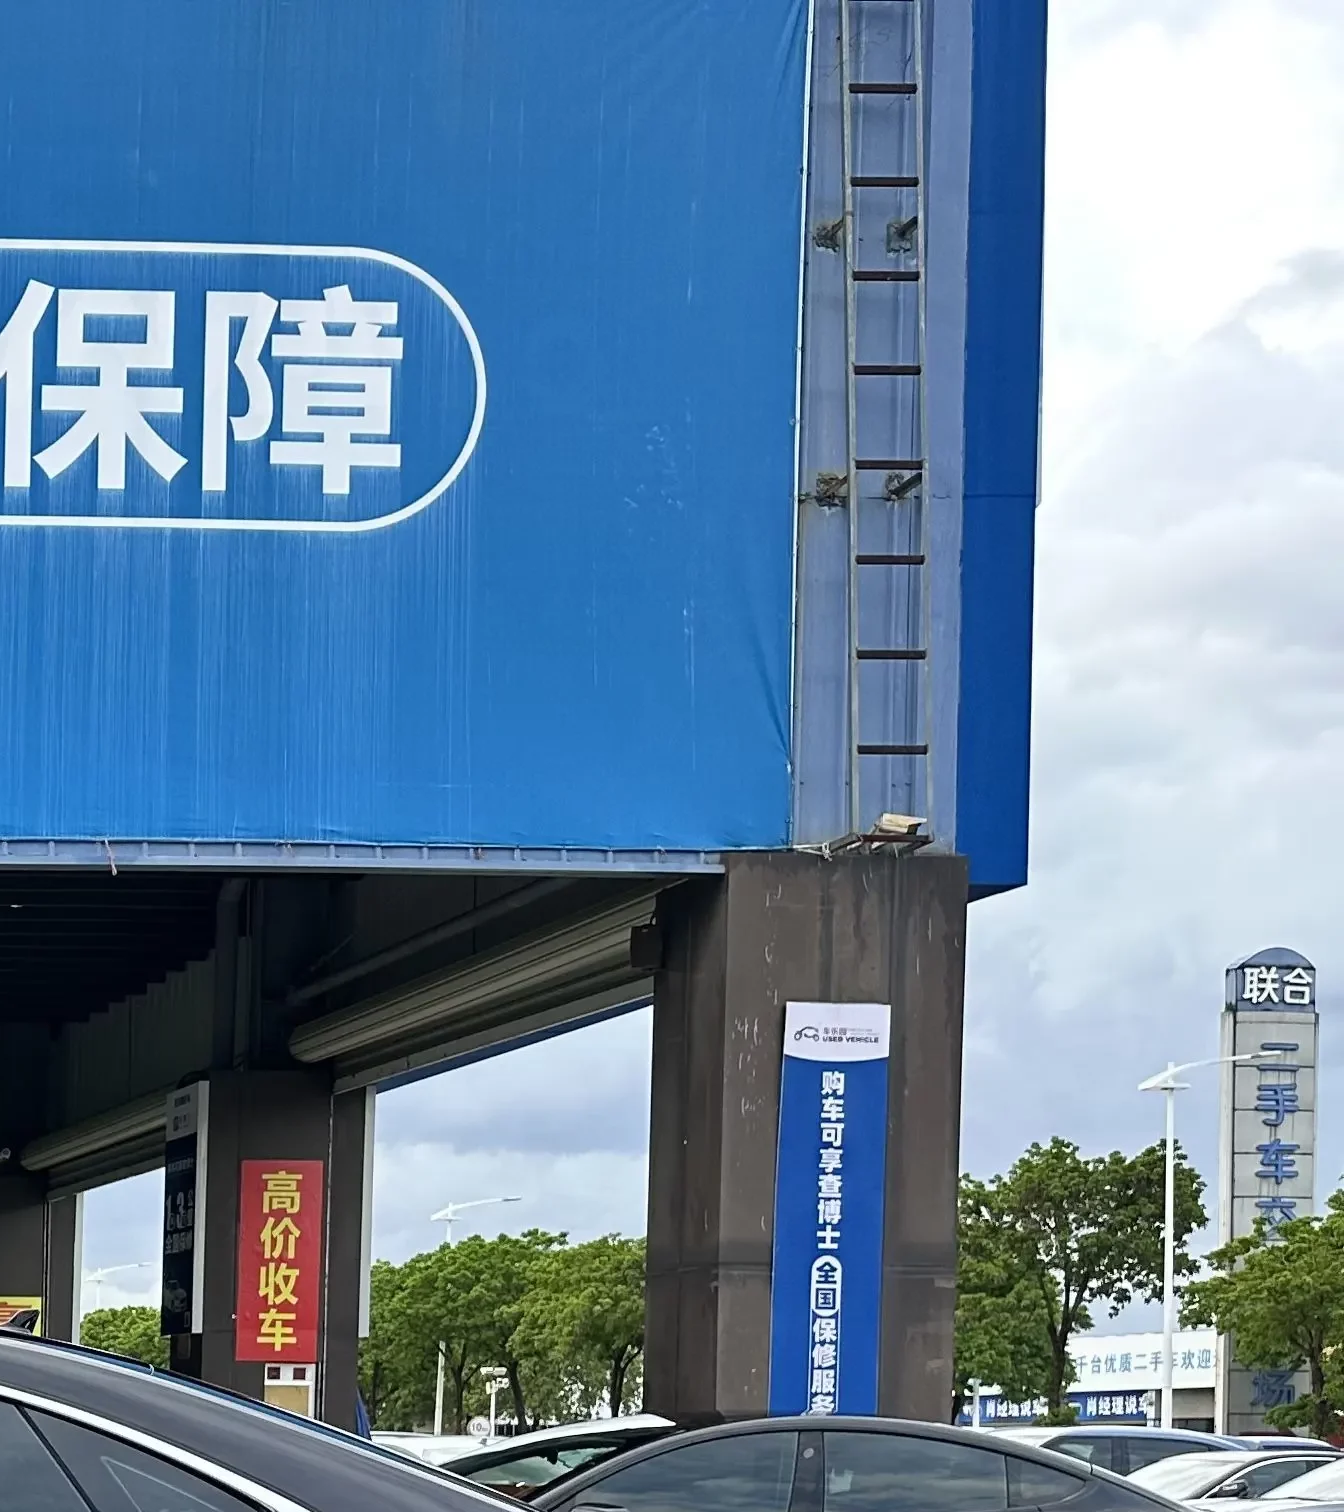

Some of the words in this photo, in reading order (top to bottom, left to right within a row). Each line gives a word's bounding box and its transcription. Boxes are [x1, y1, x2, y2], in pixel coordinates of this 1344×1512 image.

[1242, 966, 1314, 1006] 联合
[816, 1070, 846, 1251] 购车可享查博士
[256, 1169, 302, 1353] 高价收车
